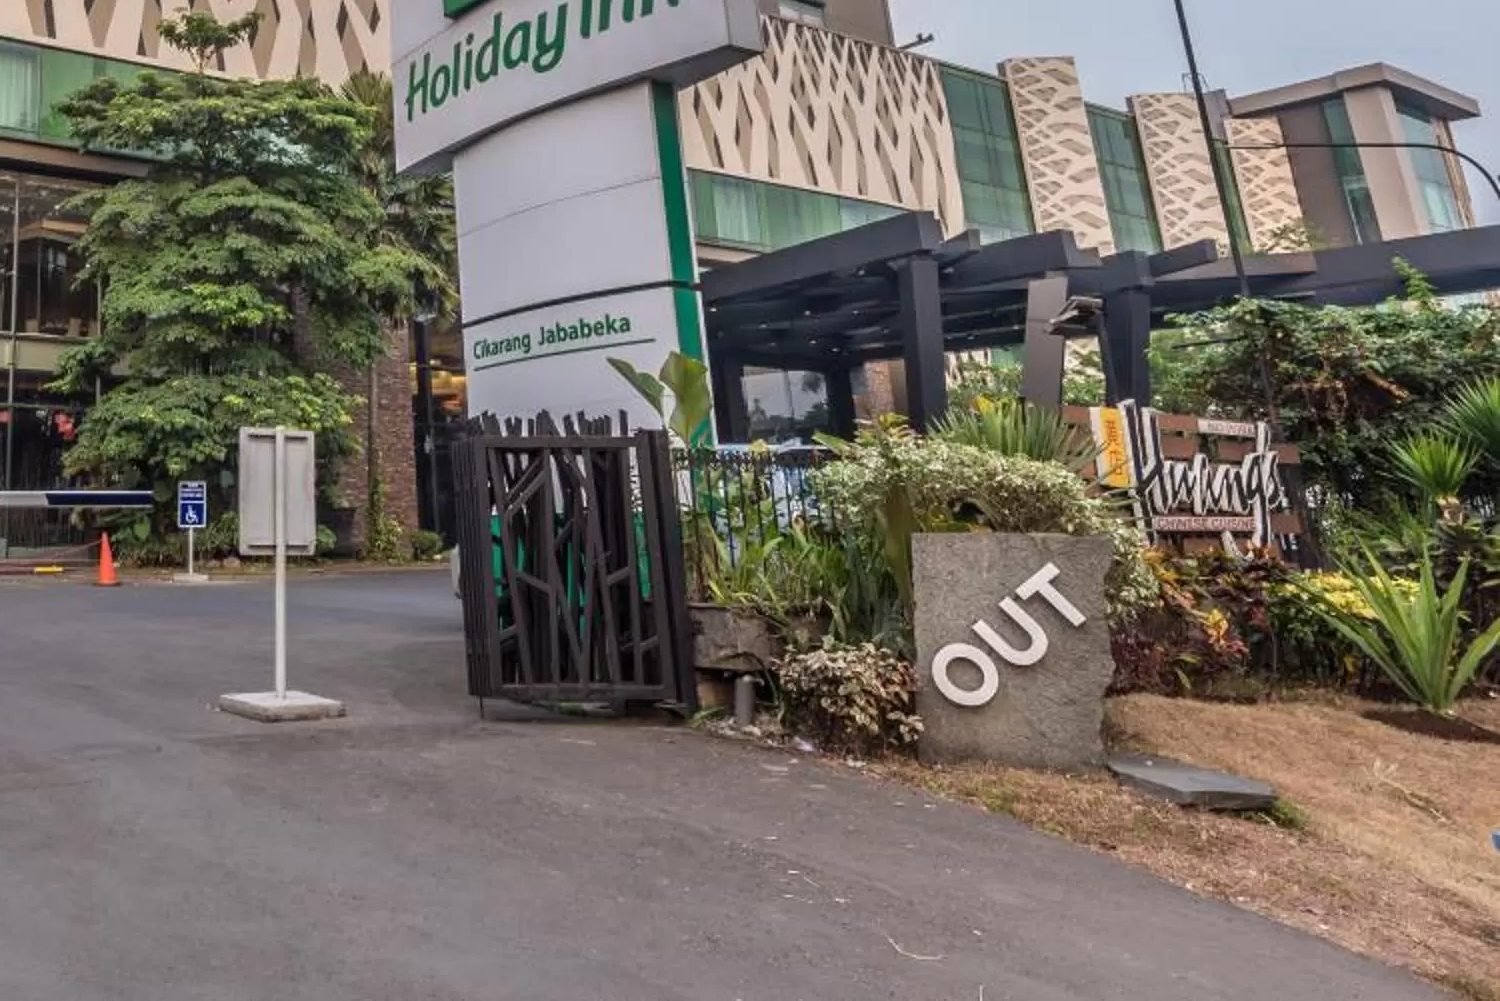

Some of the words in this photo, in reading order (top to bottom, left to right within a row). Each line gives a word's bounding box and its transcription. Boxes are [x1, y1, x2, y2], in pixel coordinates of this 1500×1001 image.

[405, 2, 568, 122] Holiday
[473, 333, 531, 359] Cikarang
[538, 314, 631, 346] Jababeka
[932, 562, 1087, 707] OUT
